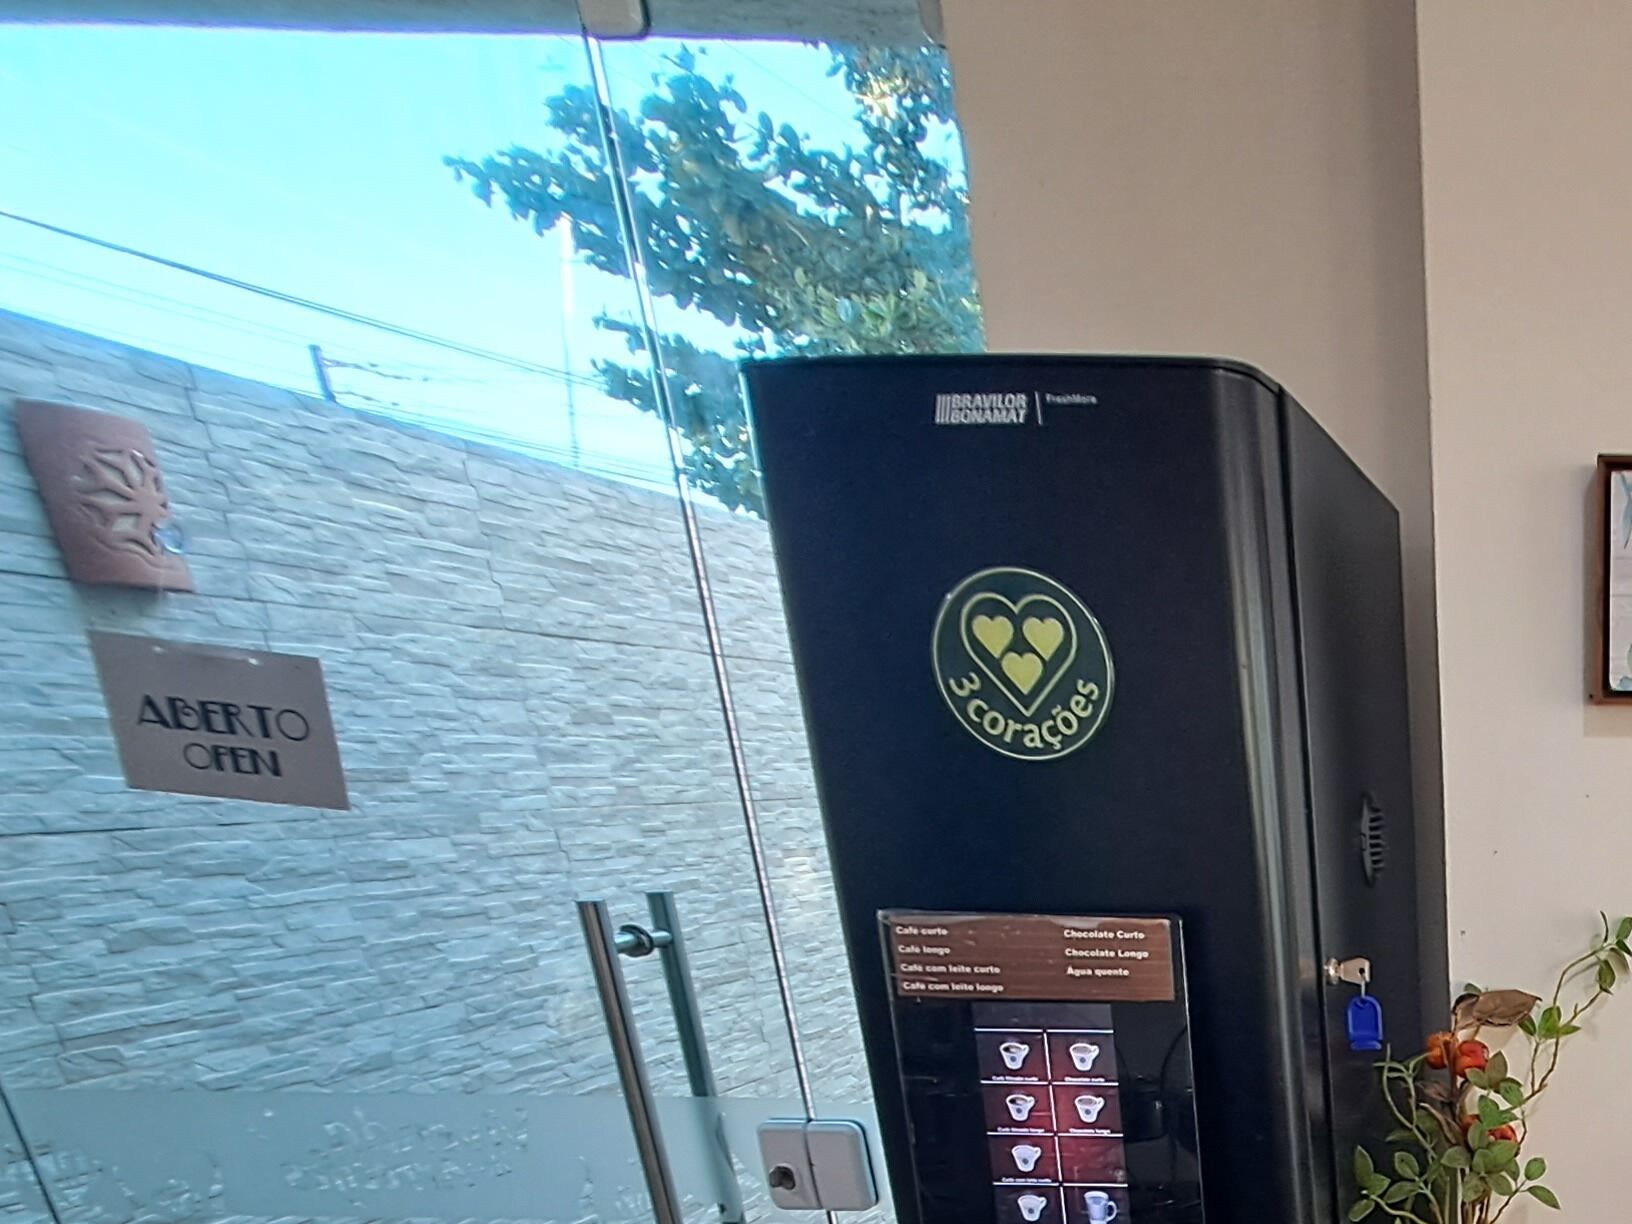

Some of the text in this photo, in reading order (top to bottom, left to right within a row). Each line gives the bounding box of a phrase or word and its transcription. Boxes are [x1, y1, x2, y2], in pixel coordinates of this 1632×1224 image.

[949, 392, 1028, 409] BRAVILOR
[948, 408, 1027, 424] BONAMAT
[949, 671, 1099, 750] 3 corações
[137, 694, 310, 742] ABERTO
[920, 926, 949, 936] curto
[1063, 929, 1146, 940] Chocolate Curto
[922, 945, 951, 956] longo
[1064, 948, 1150, 960] Chocolate Longo
[925, 964, 948, 973] com
[949, 964, 972, 974] leite
[973, 965, 1001, 974] curto
[1066, 965, 1130, 978] Água quente
[927, 983, 950, 992] com
[951, 982, 975, 992] leite
[976, 983, 1005, 994] longo
